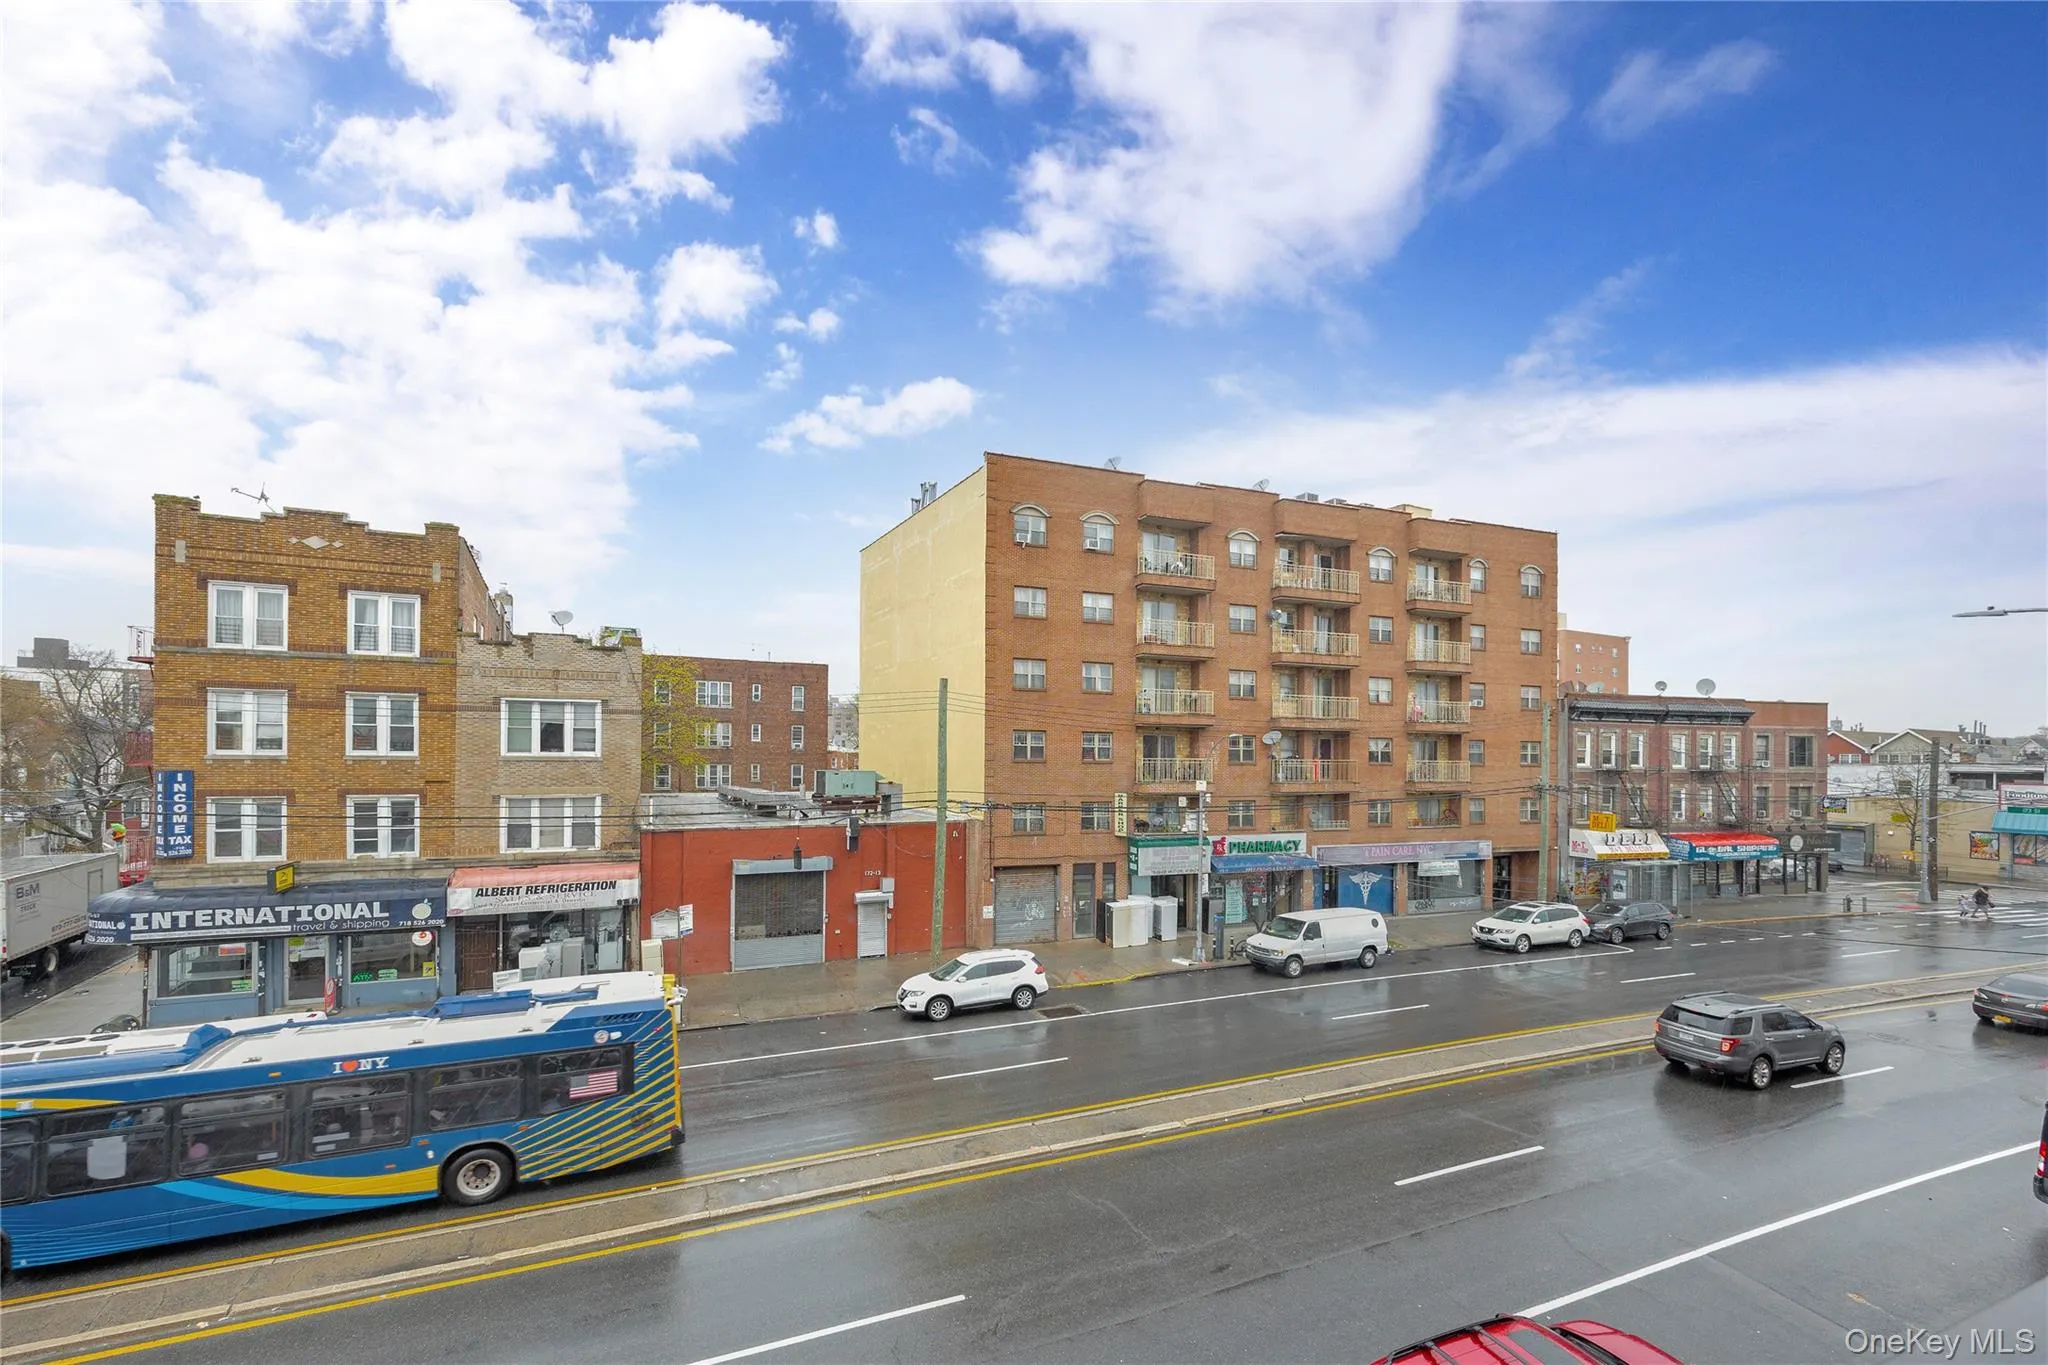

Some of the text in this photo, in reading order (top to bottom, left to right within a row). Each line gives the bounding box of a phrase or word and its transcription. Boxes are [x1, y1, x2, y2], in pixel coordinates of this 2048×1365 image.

[168, 772, 192, 845] INCOME TAX
[1229, 839, 1302, 854] PHARMACY
[1605, 833, 1653, 846] DELI
[1371, 846, 1391, 857] PAIN
[1392, 845, 1415, 856] CARE
[1416, 844, 1434, 855] NYC
[475, 880, 617, 898] ALBERT REFRIGERATION
[130, 902, 389, 931] INTERNATIONAL
[293, 919, 390, 932] travel & shipping
[332, 1056, 390, 1074] I NY
